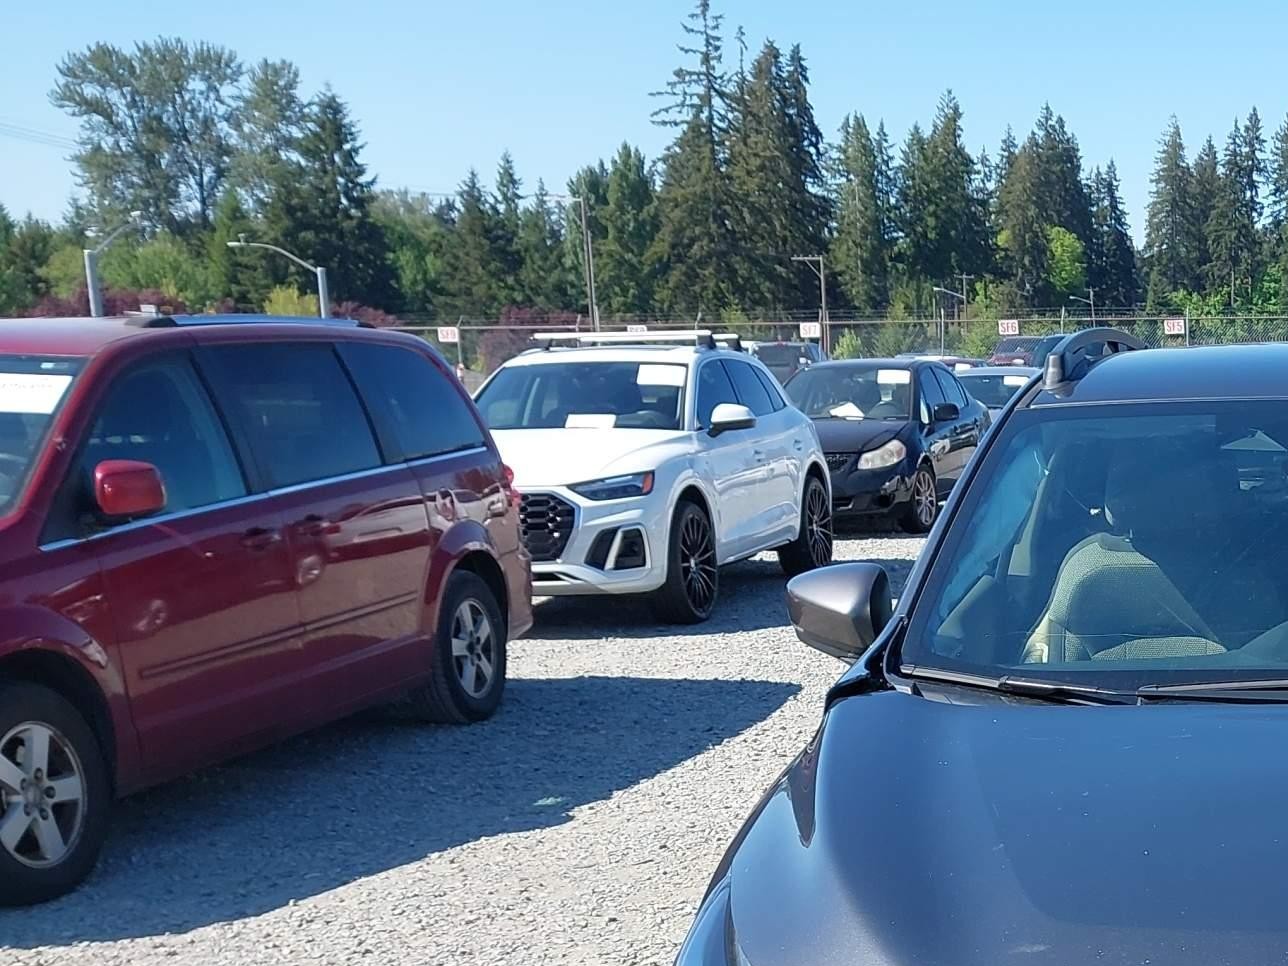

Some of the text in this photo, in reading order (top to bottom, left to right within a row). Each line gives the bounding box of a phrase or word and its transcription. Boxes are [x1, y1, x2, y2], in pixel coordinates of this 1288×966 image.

[802, 324, 817, 336] SF7
[1000, 321, 1017, 333] SF6
[1166, 321, 1183, 332] SF5
